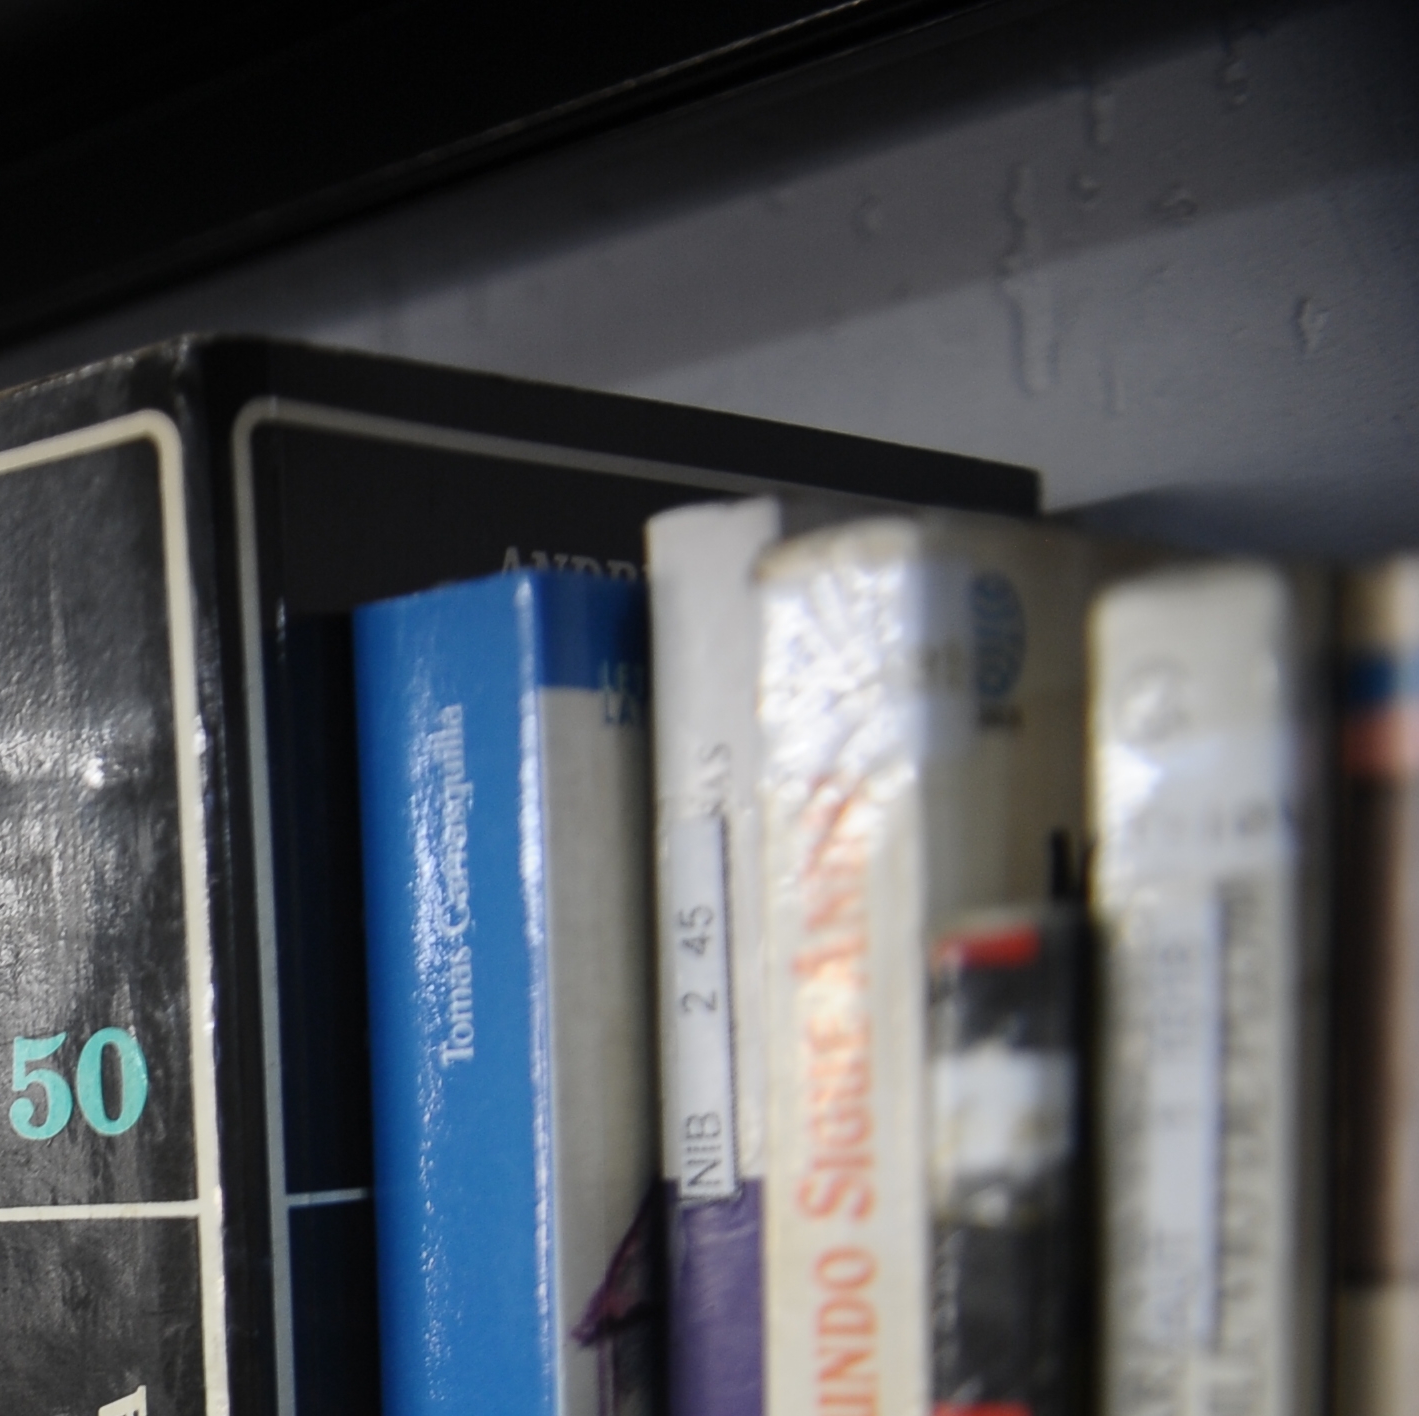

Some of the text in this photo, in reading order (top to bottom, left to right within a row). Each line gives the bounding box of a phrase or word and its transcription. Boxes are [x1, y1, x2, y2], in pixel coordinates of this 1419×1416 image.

[8, 1027, 148, 1140] 50
[678, 905, 723, 1190] NIB 2 45
